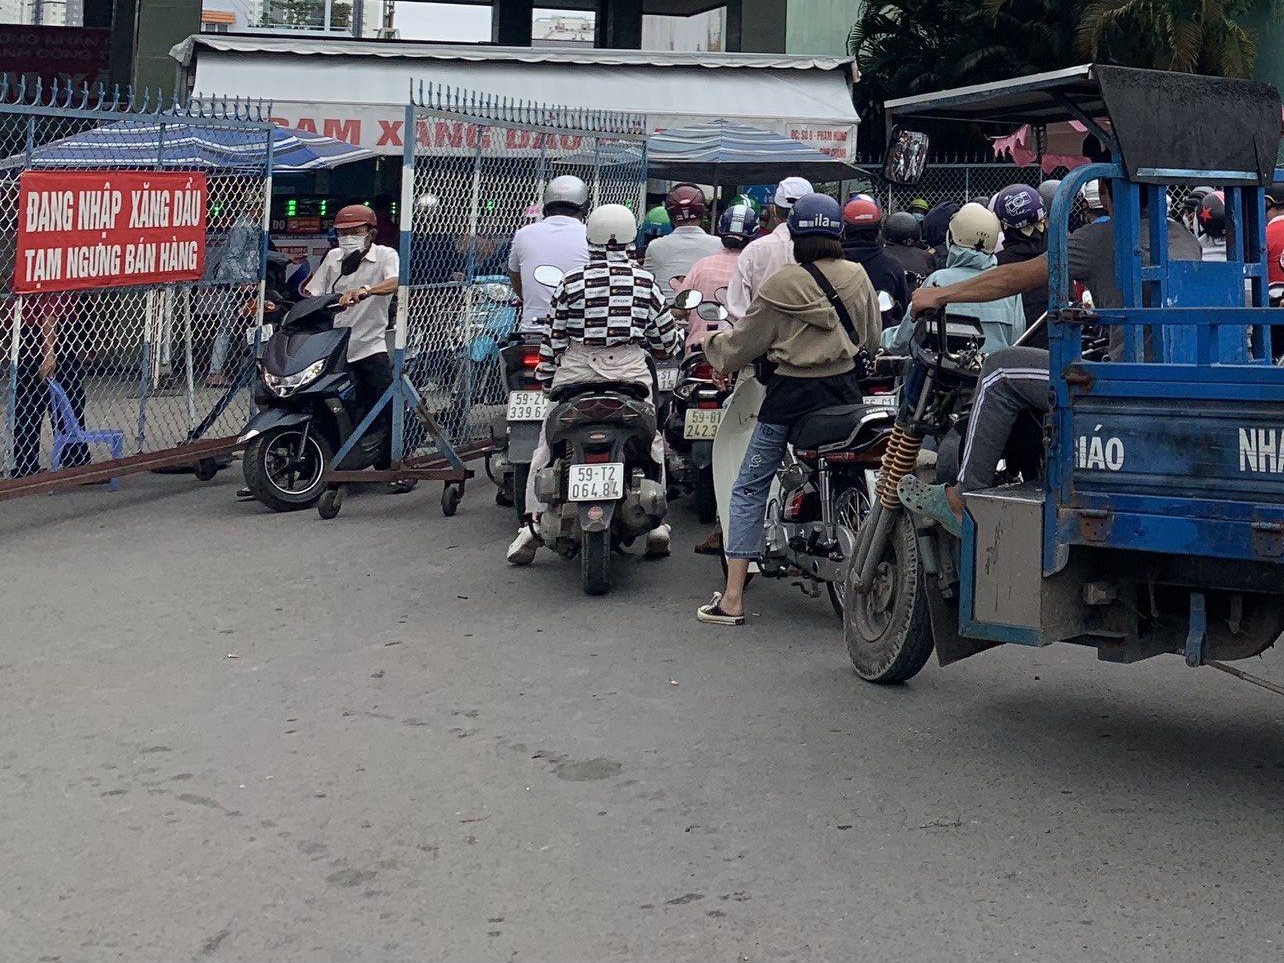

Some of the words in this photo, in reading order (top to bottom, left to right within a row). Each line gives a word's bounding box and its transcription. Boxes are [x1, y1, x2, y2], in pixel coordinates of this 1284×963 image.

[26, 190, 74, 233] ĐANG
[78, 182, 122, 238] NHẬP
[129, 182, 171, 228] XĂNG
[814, 214, 830, 227] ila
[25, 247, 62, 288] TẠM
[124, 237, 156, 274] BÁN
[159, 236, 198, 271] HÀNG
[692, 411, 721, 424] 59-B1
[1074, 424, 1125, 471] IÁO
[578, 467, 615, 482] 59-T2
[572, 483, 619, 499] 064.84
